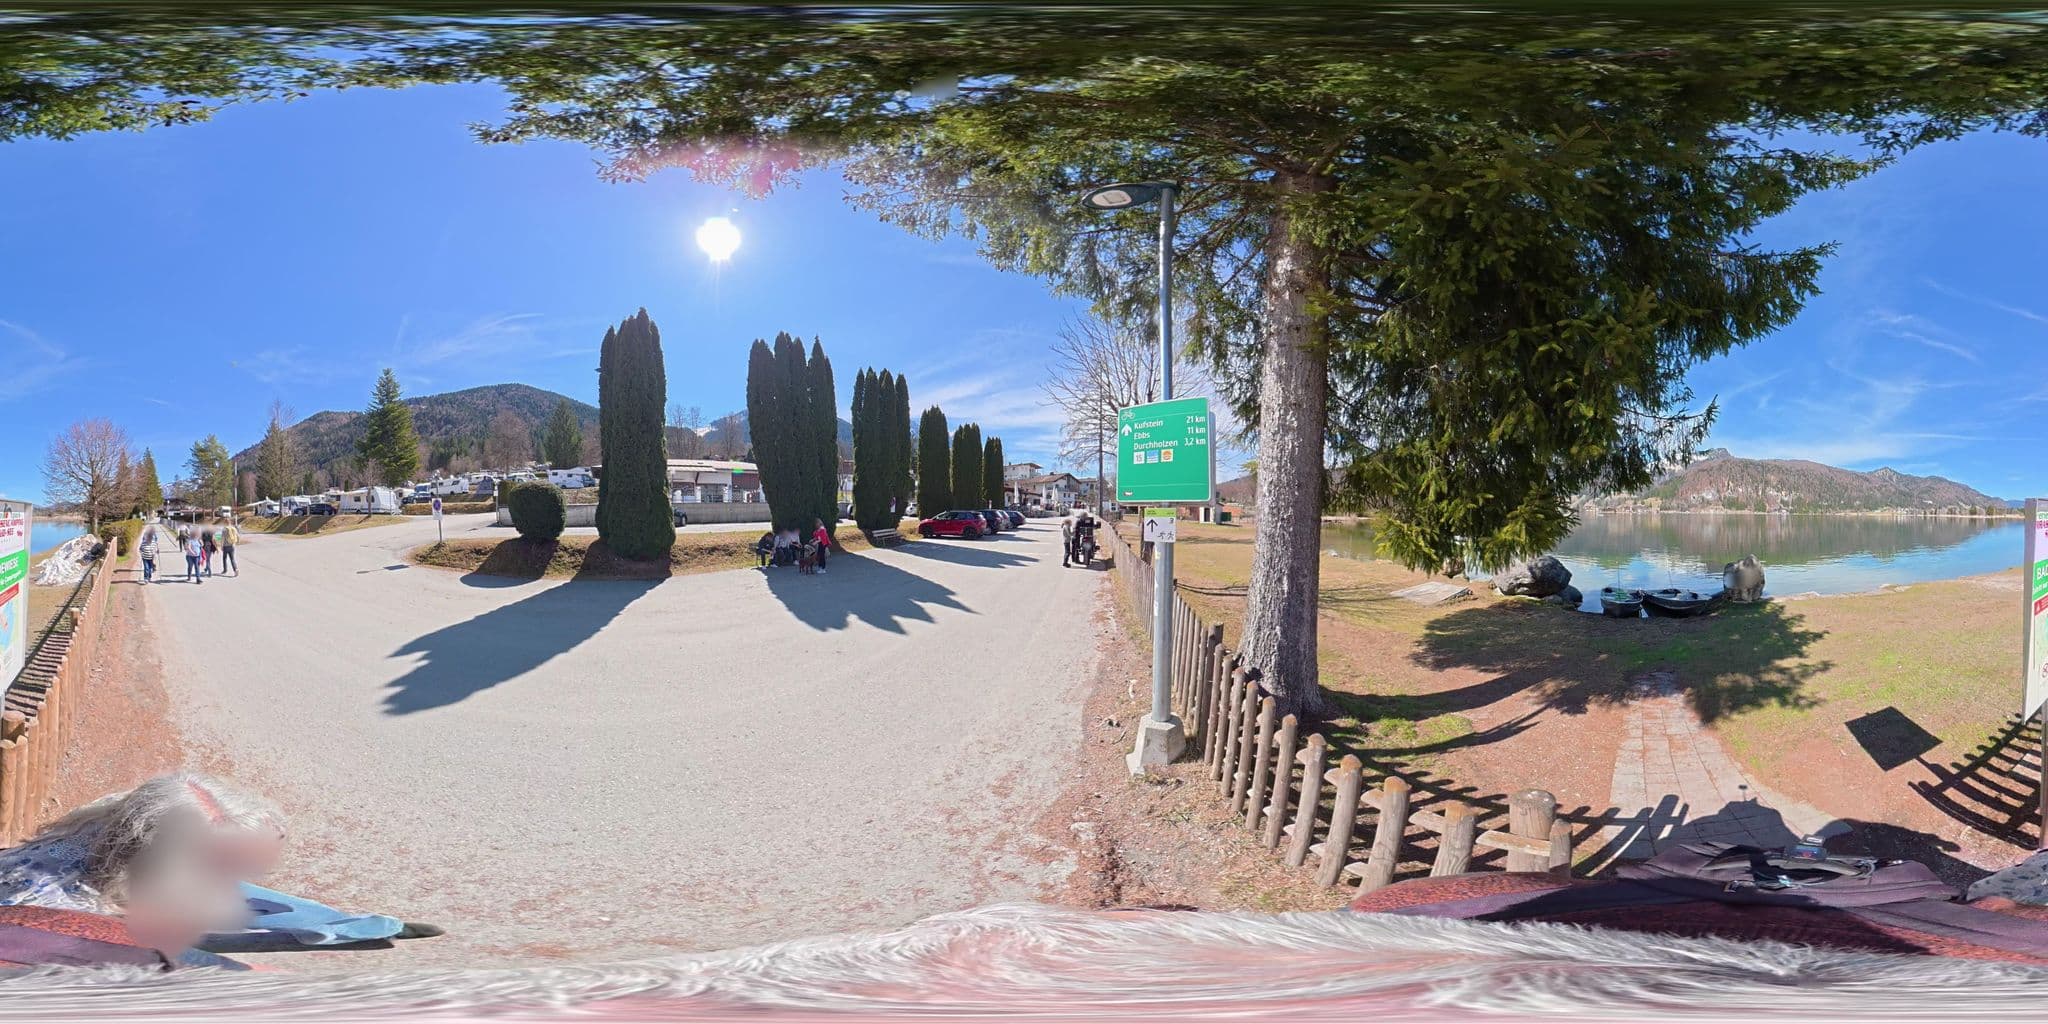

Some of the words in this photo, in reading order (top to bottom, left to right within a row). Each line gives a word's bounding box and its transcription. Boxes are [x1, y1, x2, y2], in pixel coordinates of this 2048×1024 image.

[1186, 416, 1194, 424] 21
[1195, 415, 1206, 423] km
[1134, 420, 1163, 430] Kufstein
[1195, 426, 1206, 434] km
[1134, 432, 1150, 440] Ebbs
[1134, 439, 1178, 450] Durchholzen
[1184, 438, 1194, 446] 3,2
[1195, 437, 1206, 445] km
[1136, 454, 1143, 462] 15
